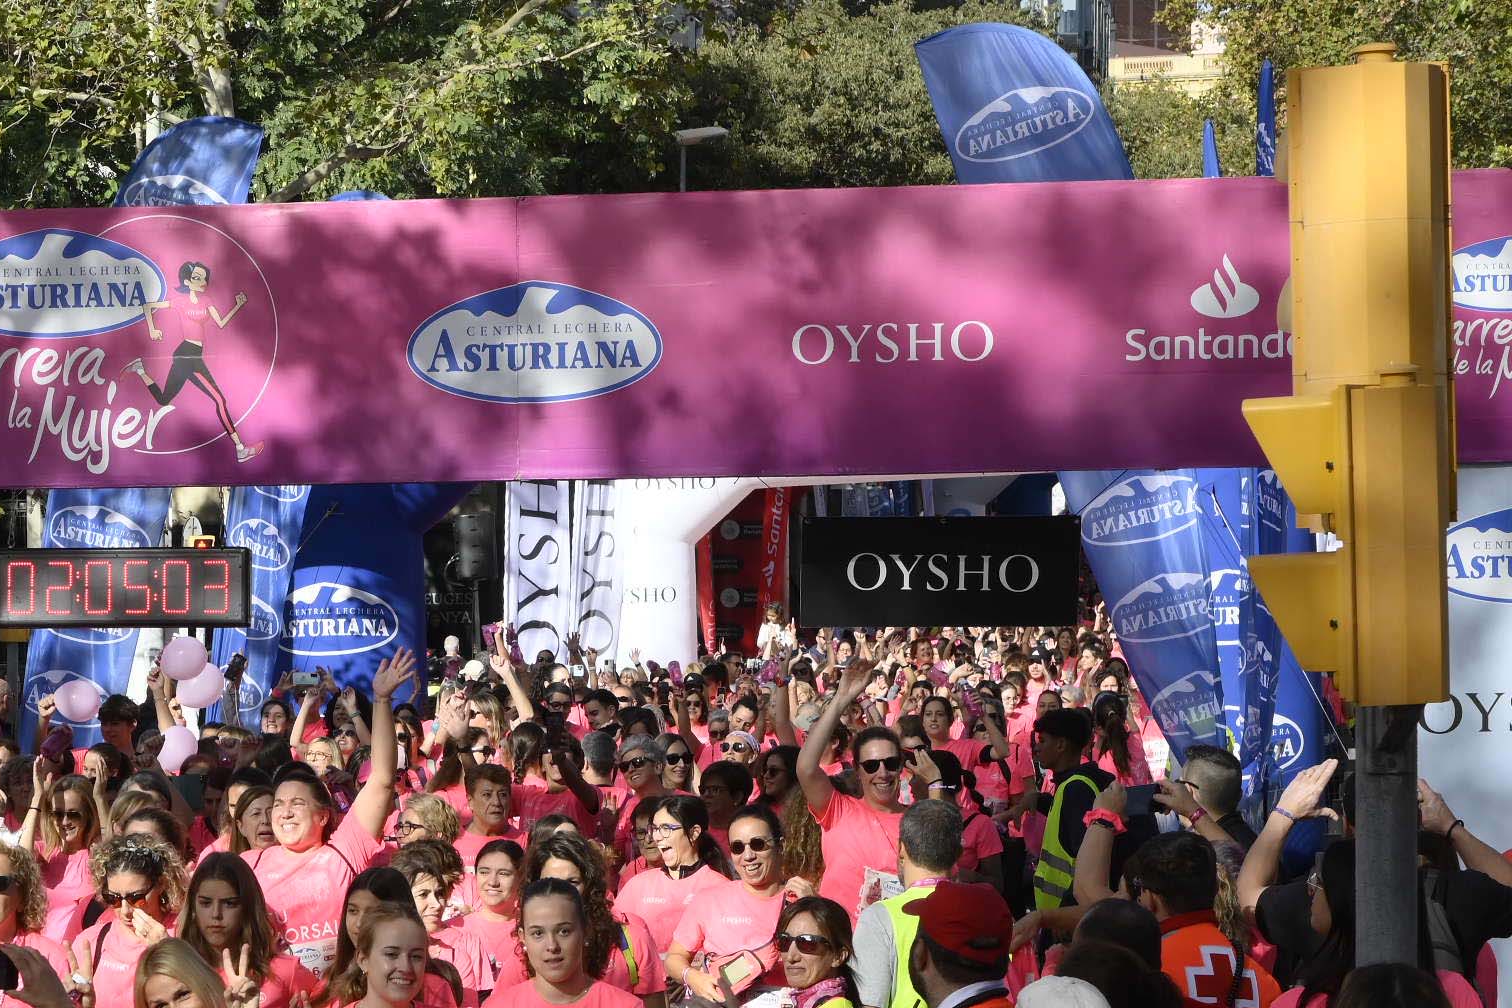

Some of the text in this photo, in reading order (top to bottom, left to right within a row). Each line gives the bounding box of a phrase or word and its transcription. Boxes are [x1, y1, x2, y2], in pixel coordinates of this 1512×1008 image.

[69, 264, 141, 276] LECHERA
[466, 322, 633, 337] CENTRAL LECHERA
[792, 320, 994, 364] OYSHO
[1125, 326, 1294, 362] Santand
[427, 328, 642, 373] ASTURIANA
[1476, 347, 1493, 374] la
[8, 394, 32, 428] la
[28, 381, 175, 474] Mujer
[7, 560, 229, 615] 02:05:03
[846, 552, 1040, 593] OYSHO
